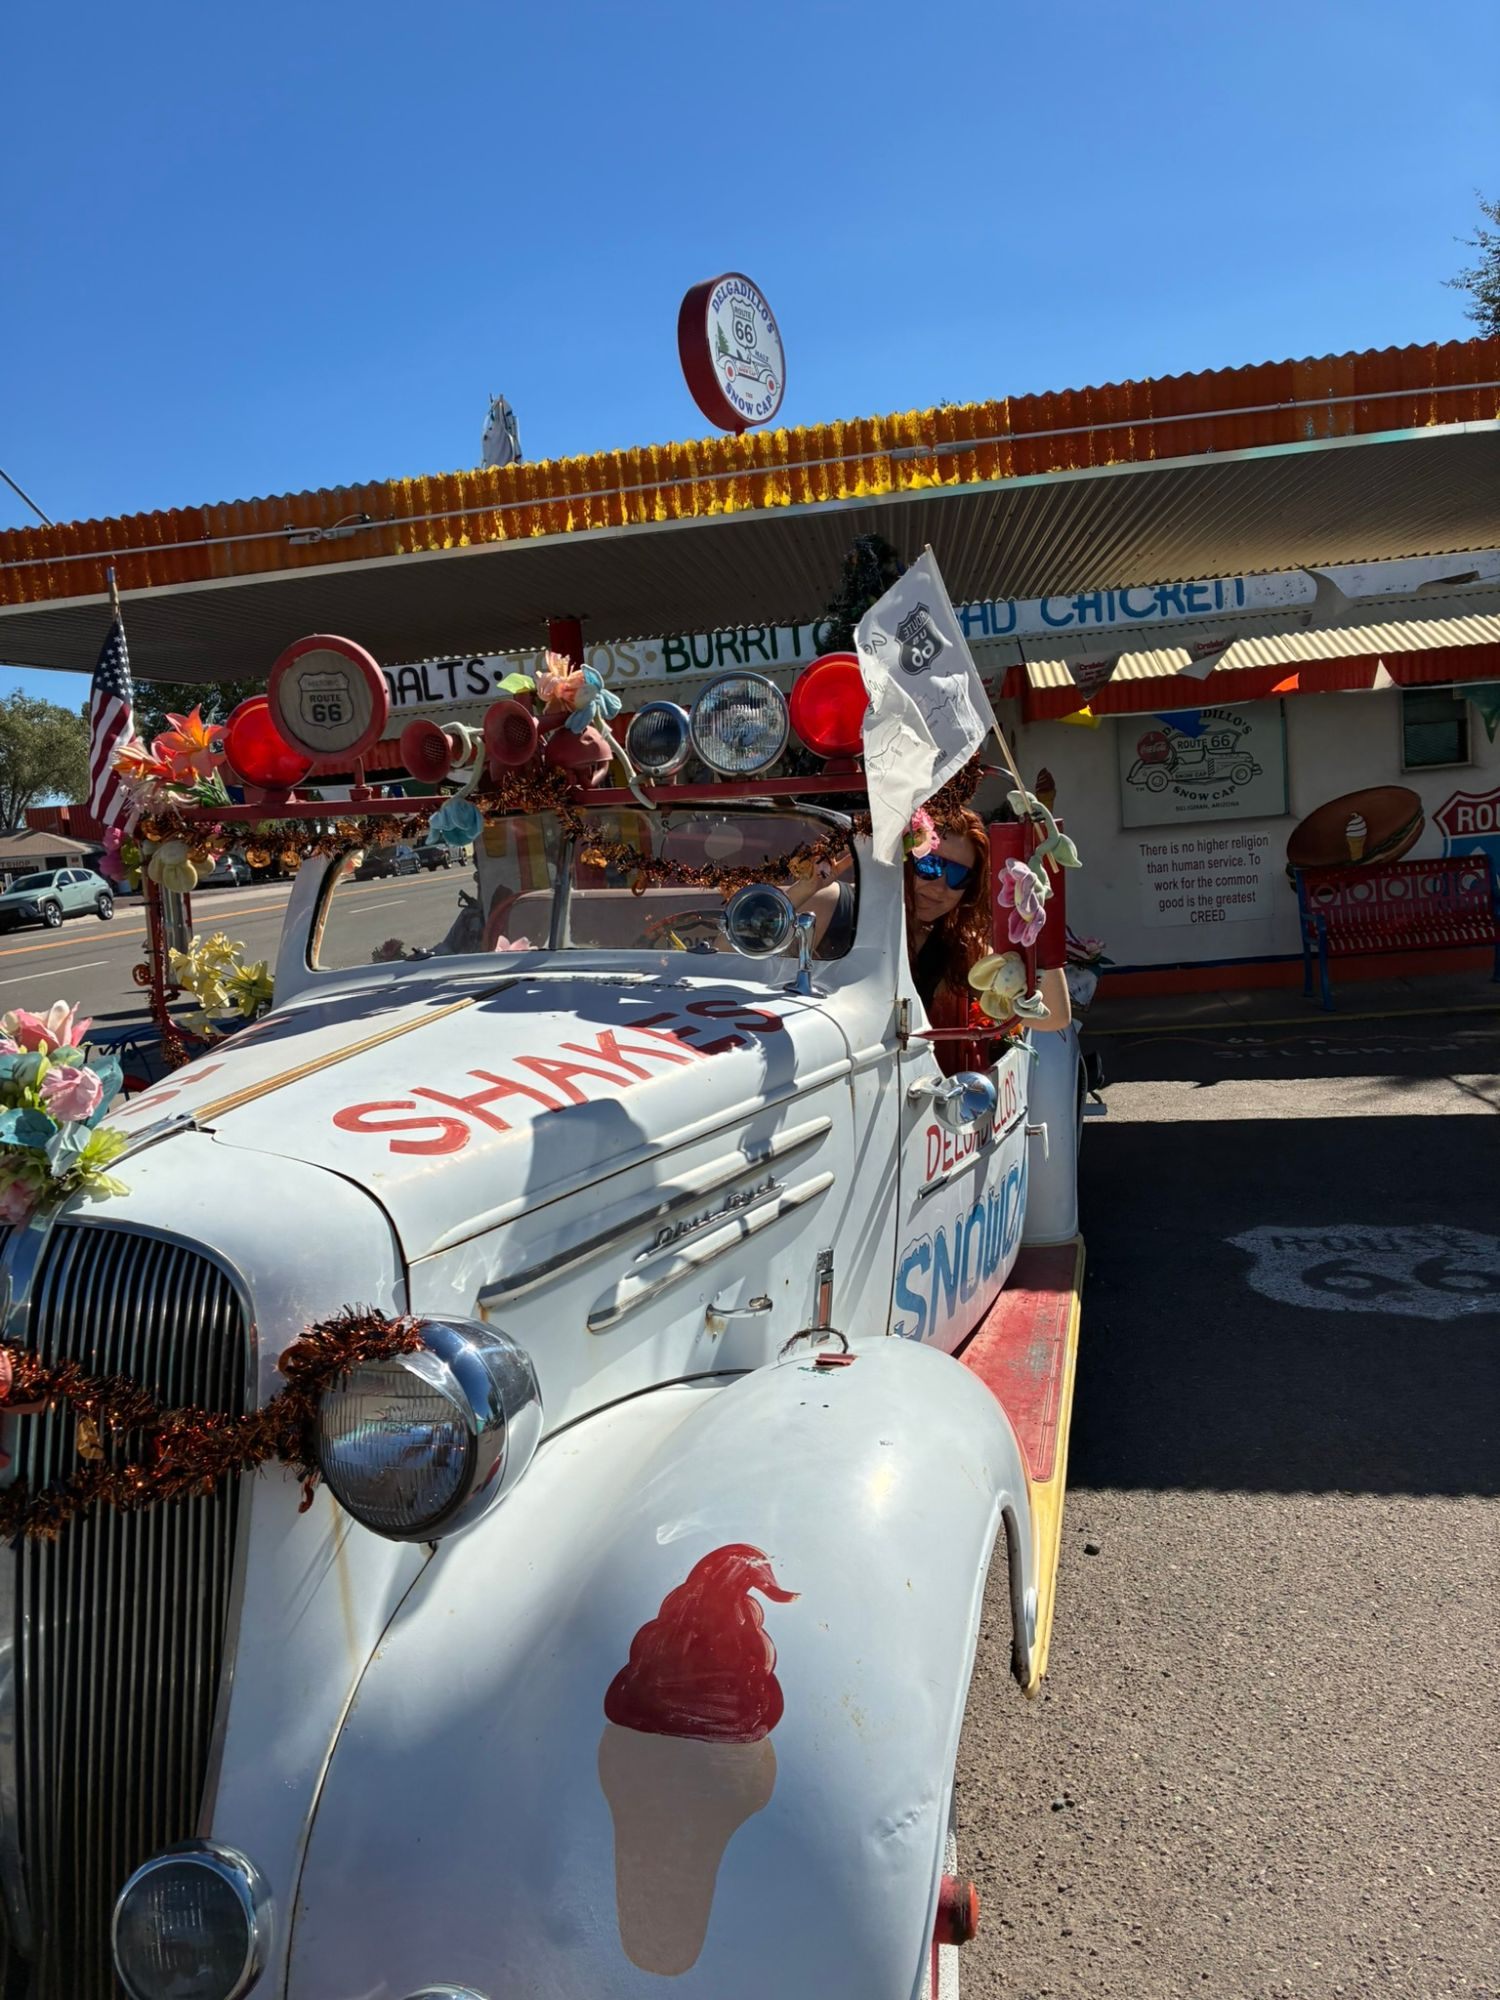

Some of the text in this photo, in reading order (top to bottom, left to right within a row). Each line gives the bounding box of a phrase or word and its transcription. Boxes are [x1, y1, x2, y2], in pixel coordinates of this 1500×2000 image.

[712, 281, 775, 334] DELGADILLO'S
[735, 306, 752, 320] ROUTE
[735, 320, 754, 344] 66
[725, 382, 773, 416] SNOW CAP
[383, 659, 490, 705] ALTS
[504, 644, 641, 681] TOS
[309, 694, 342, 703] ROUTE
[312, 704, 342, 721] 66
[1162, 709, 1252, 737] DDILLO'S
[1177, 735, 1230, 750] ROUTE 66
[1173, 785, 1236, 801] SNOW CAP
[1211, 801, 1239, 809] ARIZONA
[1457, 802, 1500, 833] RO
[1139, 835, 1269, 857] There is no higher religion
[1147, 853, 1261, 874] than human service. To
[1154, 874, 1258, 891] work for the common
[1159, 891, 1256, 912] good is the greatest
[1190, 909, 1226, 923] CREED
[333, 1000, 784, 1156] SHAKES
[1301, 1256, 1500, 1301] 66
